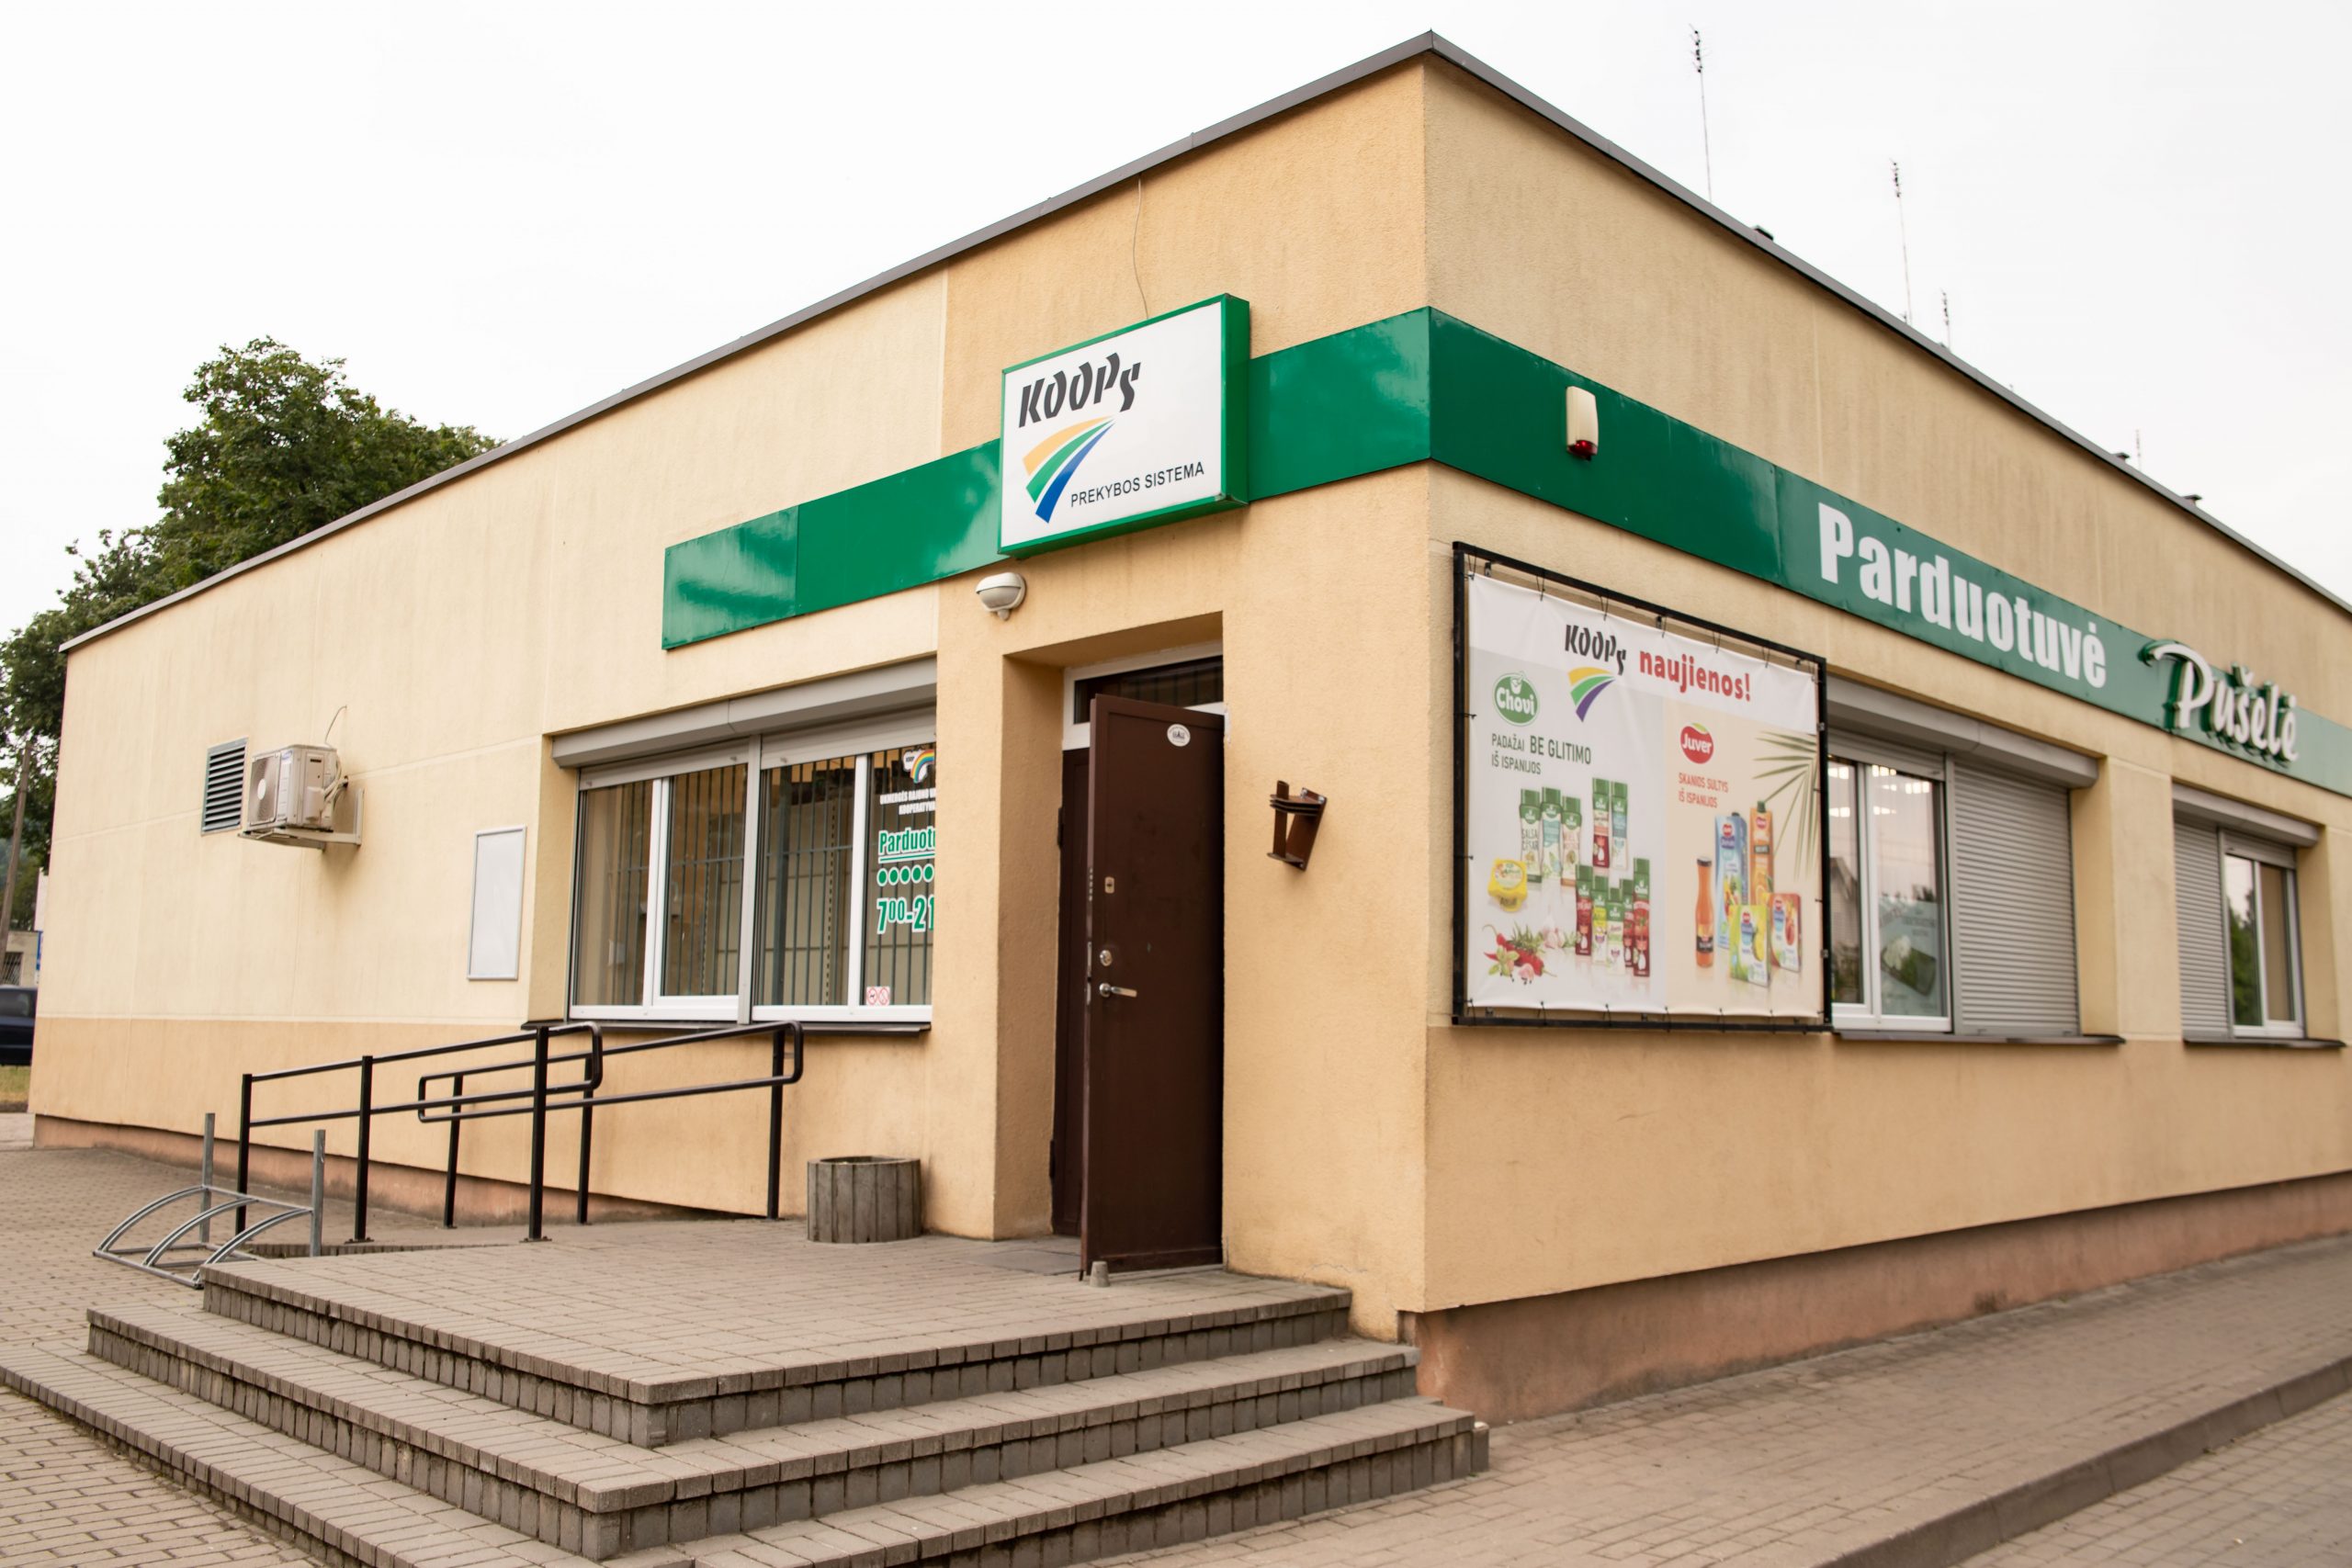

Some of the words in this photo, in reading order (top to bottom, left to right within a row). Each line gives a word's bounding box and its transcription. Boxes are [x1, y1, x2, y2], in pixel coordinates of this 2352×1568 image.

[1071, 477, 1140, 507] PREKYBOS
[1145, 461, 1204, 488] SISTEMA
[1817, 502, 2106, 689] Parduotuvė
[2152, 643, 2299, 762] Pušelė
[1639, 650, 1751, 702] naujienos!
[1492, 733, 1524, 751] PADAŽAI
[1530, 735, 1544, 756] BE
[1548, 739, 1591, 765] GLITIMO
[1682, 733, 1712, 754] Juver
[1491, 750, 1499, 767] IŠ
[1501, 756, 1542, 775] ISPANIJOS
[1687, 792, 1718, 808] ISPANIJOS
[1707, 778, 1729, 794] SULTYS
